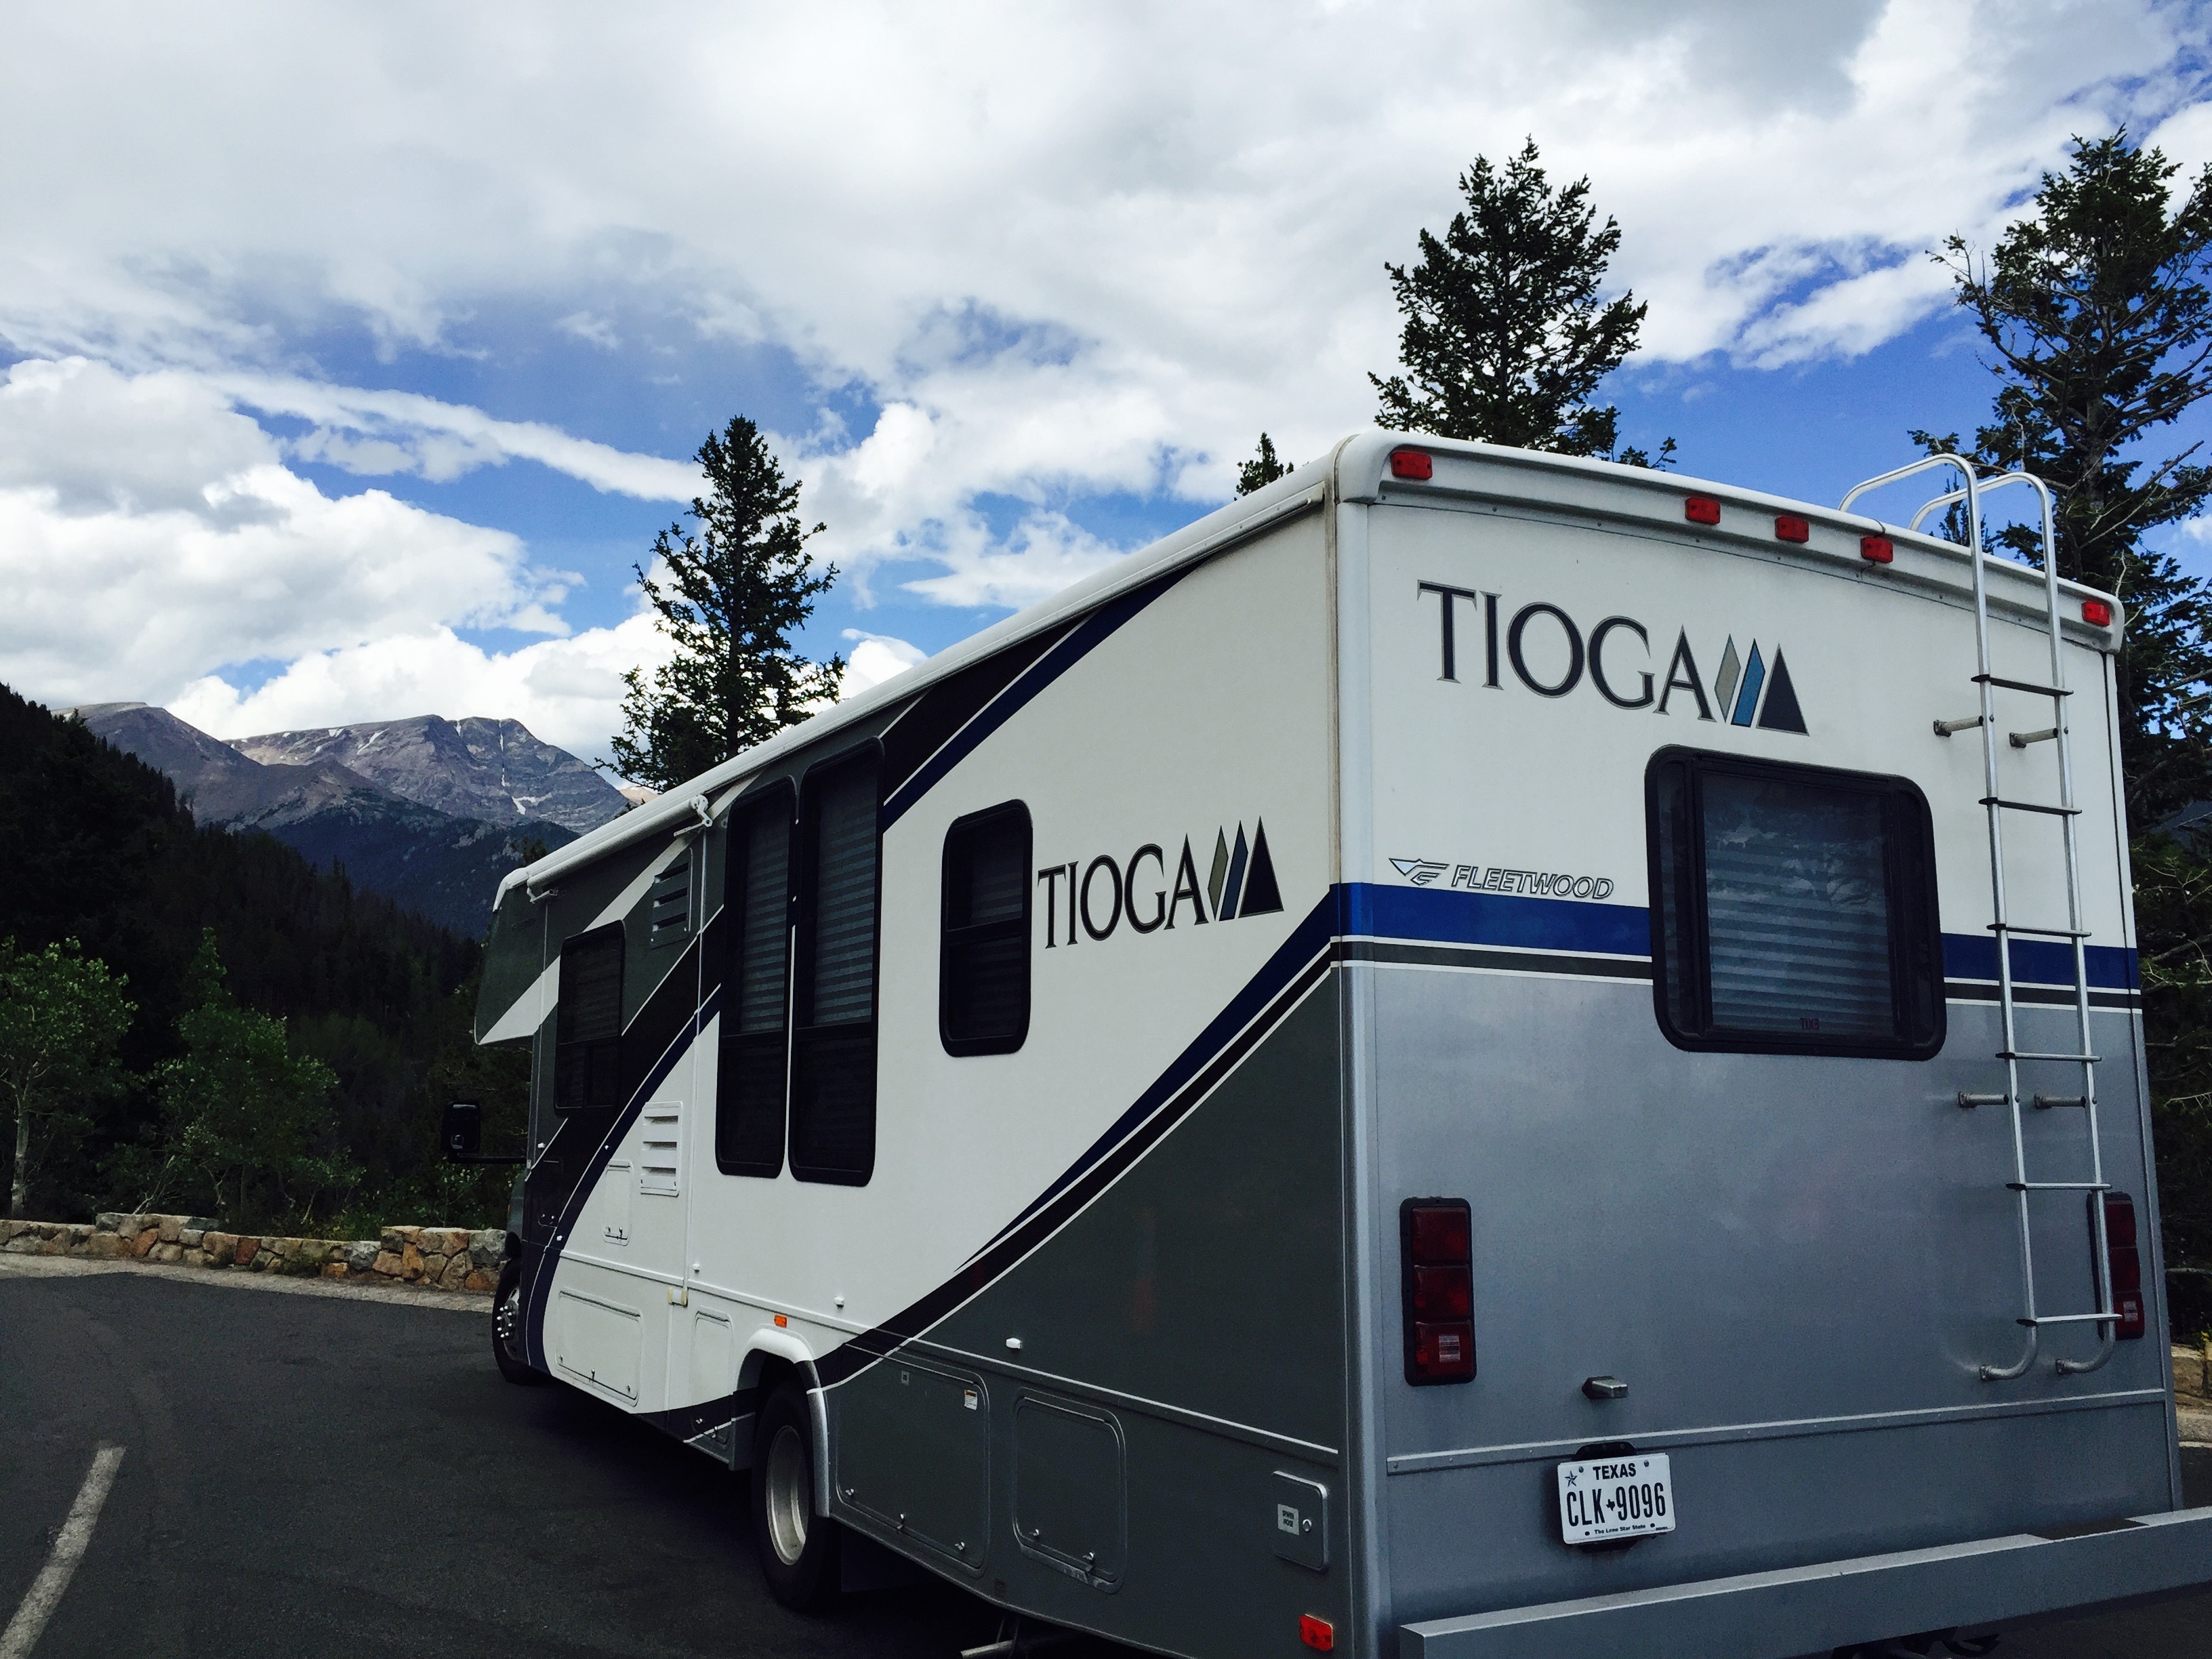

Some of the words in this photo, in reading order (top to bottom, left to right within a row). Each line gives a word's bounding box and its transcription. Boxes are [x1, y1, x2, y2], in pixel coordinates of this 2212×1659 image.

[1417, 579, 1717, 722] TIOGA
[1038, 833, 1209, 949] TIOGA
[1451, 864, 1614, 899] FLEETWOOD
[1593, 1463, 1636, 1480] TEXAS
